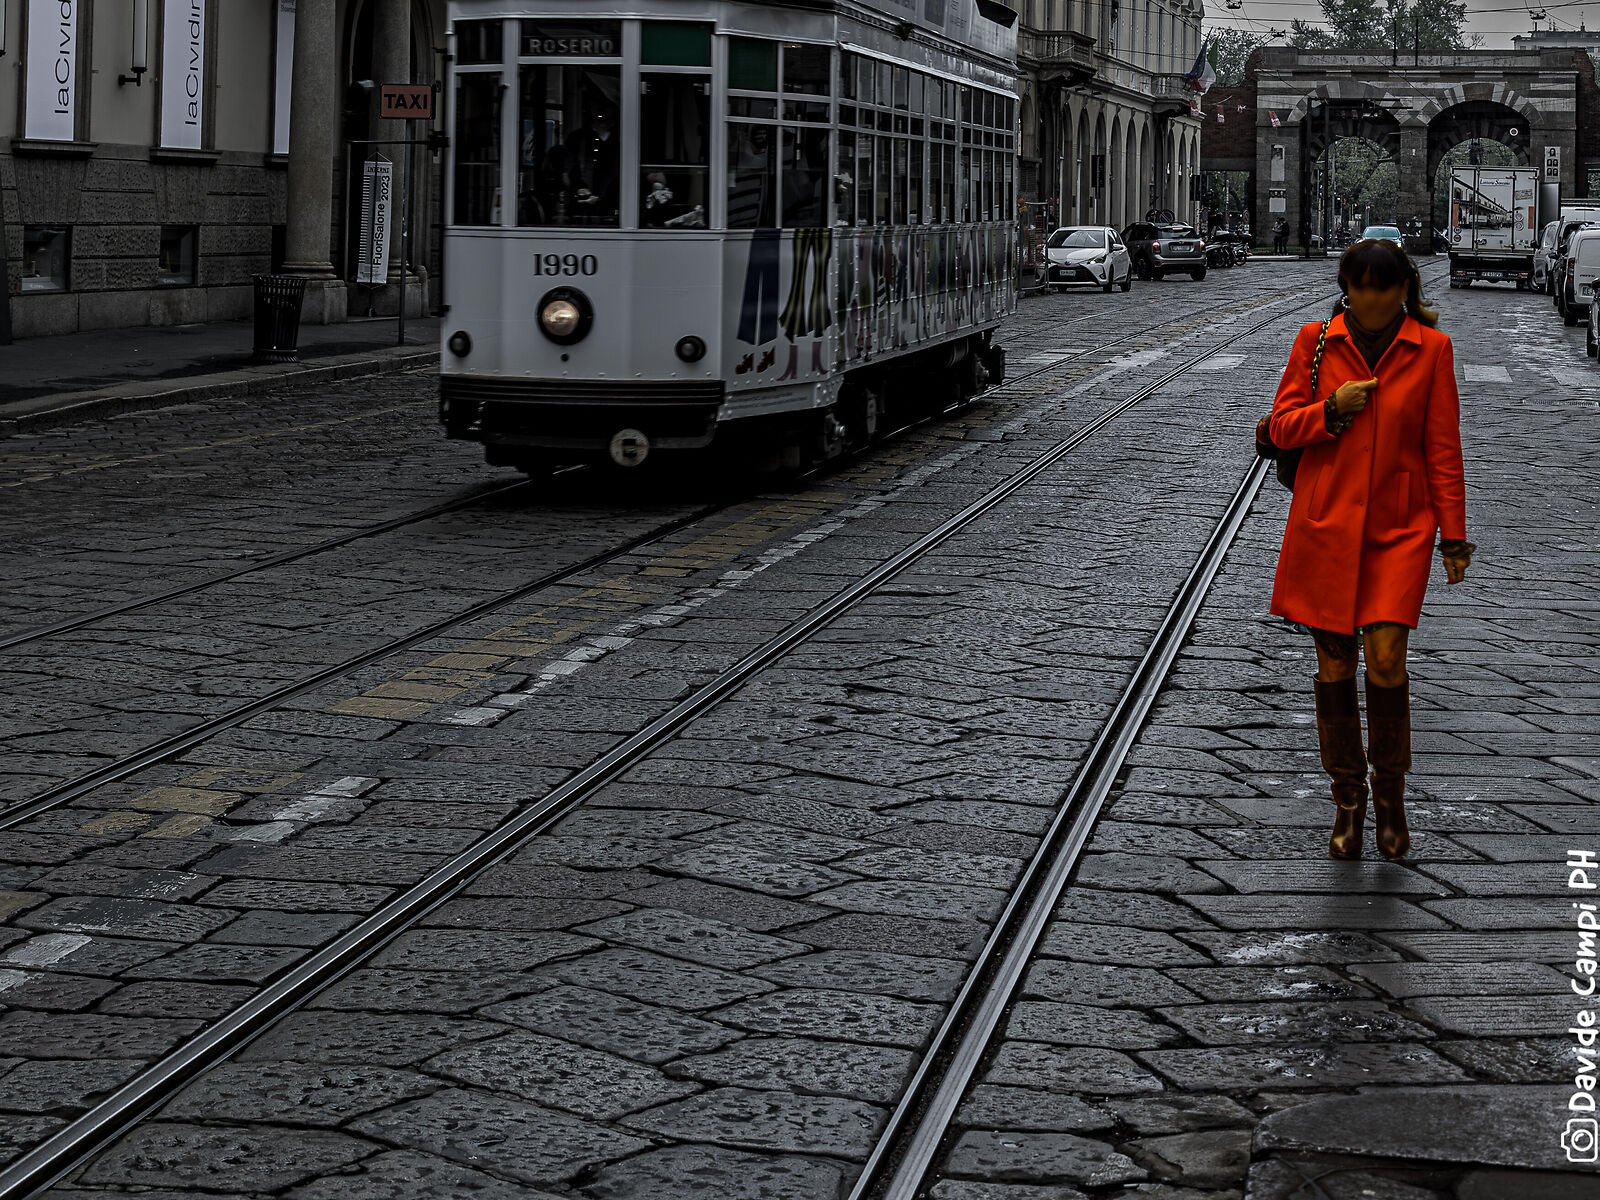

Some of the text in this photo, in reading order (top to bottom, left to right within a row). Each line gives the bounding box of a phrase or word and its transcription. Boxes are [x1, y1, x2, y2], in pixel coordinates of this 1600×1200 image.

[529, 38, 615, 54] ROSERIO
[384, 94, 428, 109] TAXI
[373, 175, 391, 266] FuoriSalone 2023
[534, 254, 597, 276] 1990
